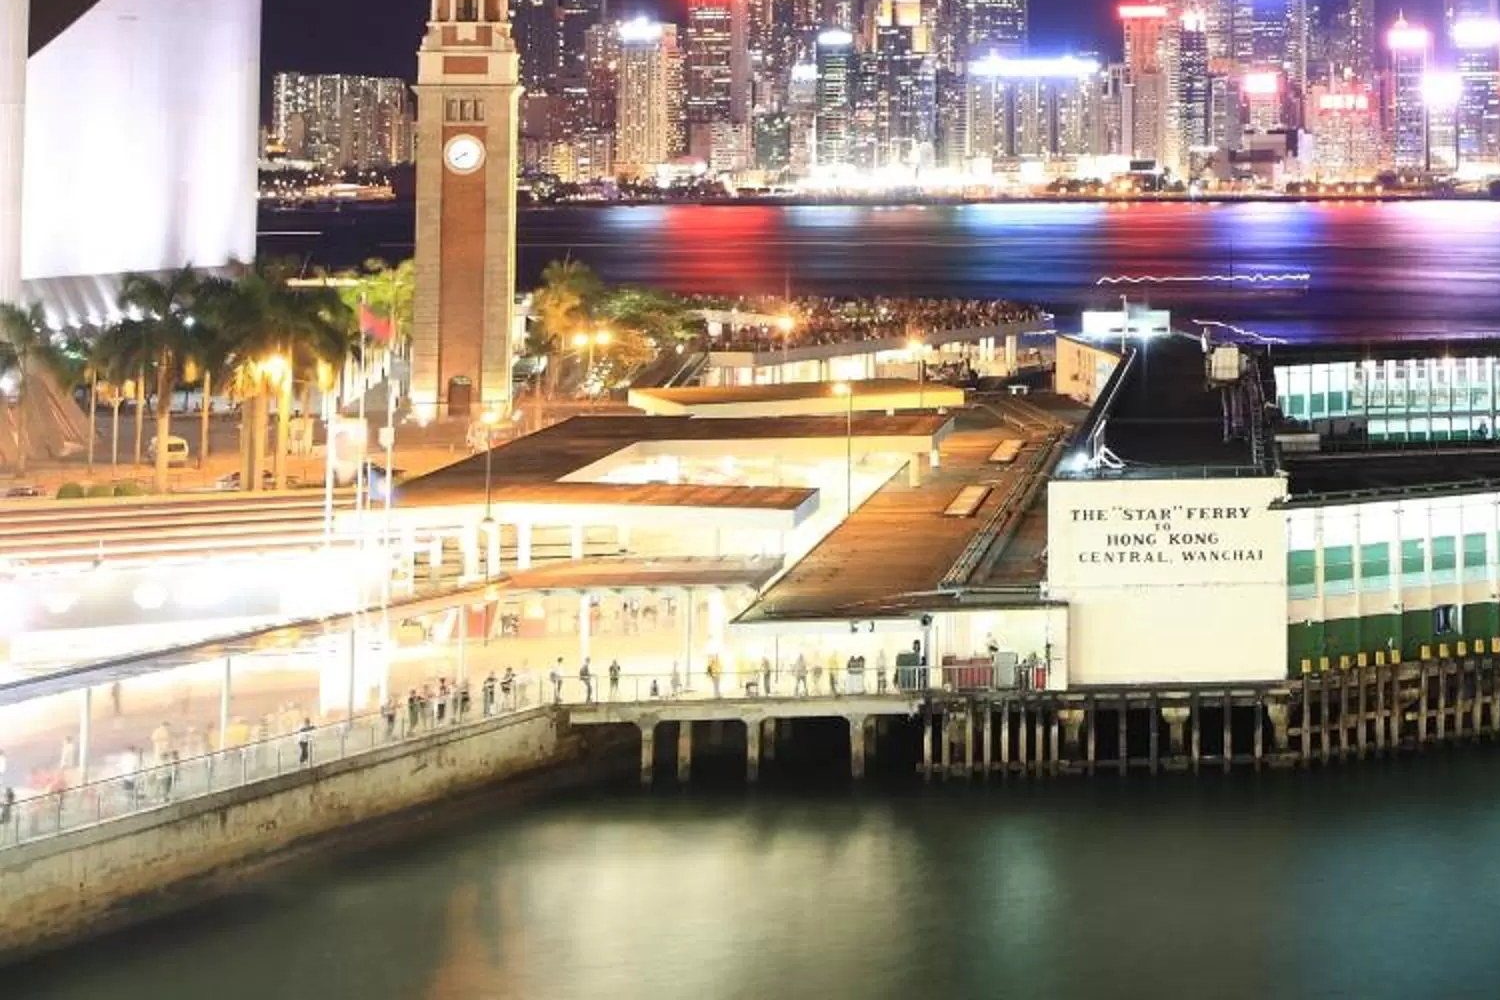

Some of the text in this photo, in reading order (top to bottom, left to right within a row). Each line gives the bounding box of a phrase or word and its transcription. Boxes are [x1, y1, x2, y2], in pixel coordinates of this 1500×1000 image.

[1071, 509, 1108, 522] THE
[1186, 506, 1251, 519] FERRY
[1154, 523, 1171, 531] TO
[1106, 532, 1219, 546] HONG KONG
[1181, 549, 1264, 562] WANCHAI
